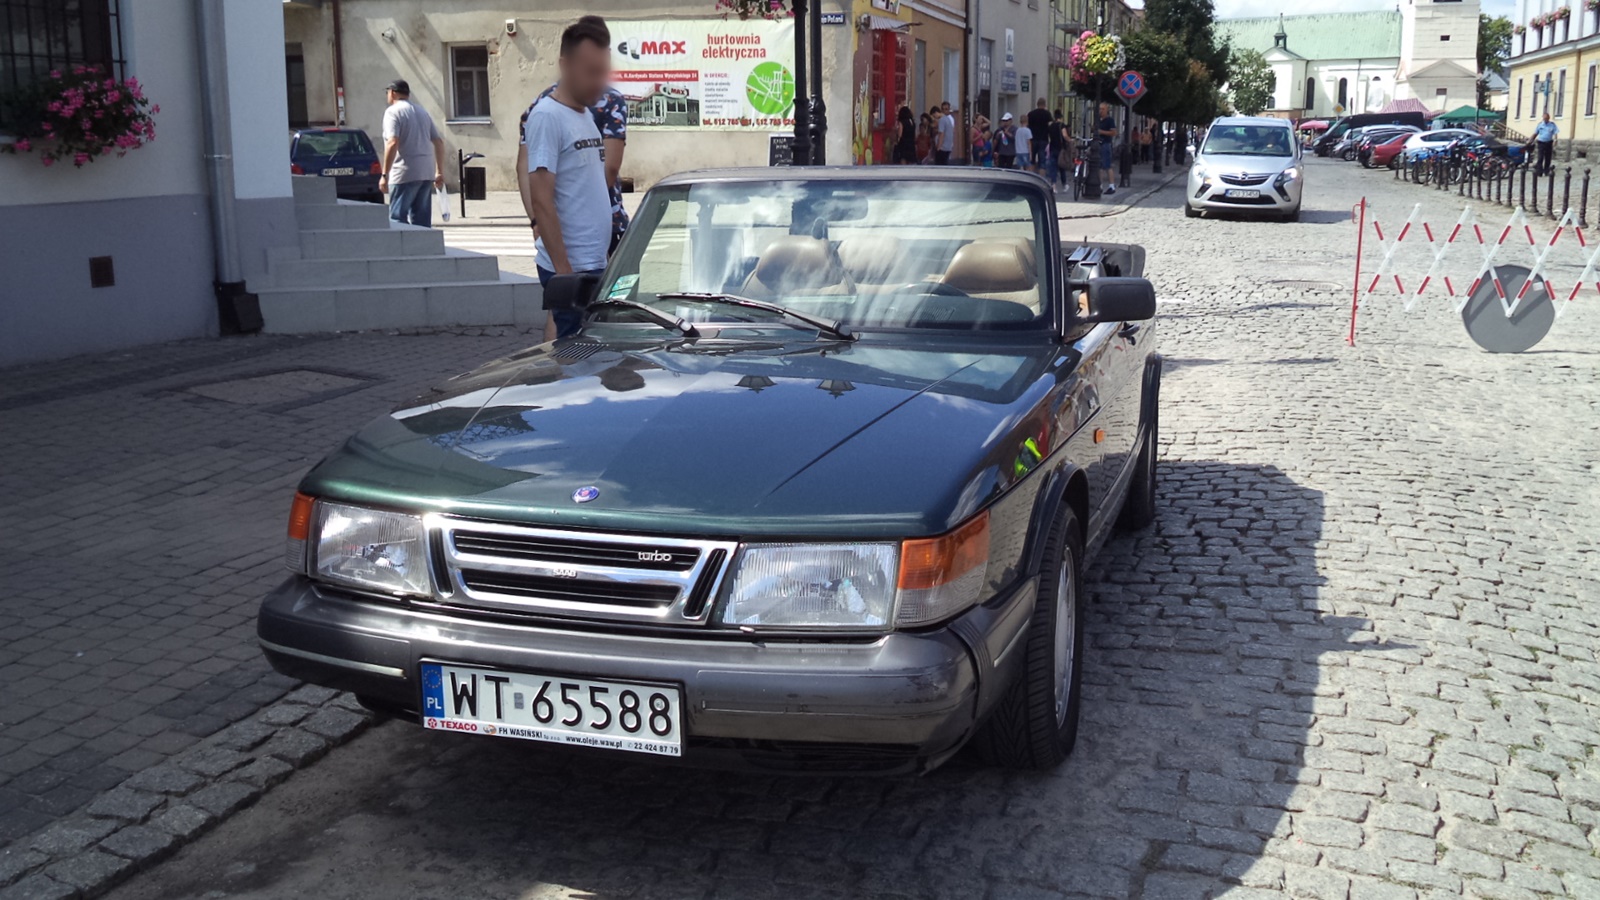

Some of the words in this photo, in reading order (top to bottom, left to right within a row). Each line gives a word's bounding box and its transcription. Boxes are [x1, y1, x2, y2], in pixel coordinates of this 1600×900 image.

[707, 33, 761, 45] hurtownia
[702, 46, 767, 61] elektryczna
[638, 550, 672, 562] turbo
[553, 568, 577, 579] SAAB
[426, 697, 442, 709] PL
[450, 672, 510, 719] WT
[532, 681, 672, 737] 65588
[440, 720, 478, 732] TEXACO
[498, 727, 508, 735] FH
[509, 727, 542, 739] WASIŃSKI
[566, 735, 623, 748] www.oleje.waw.pl
[634, 742, 643, 750] 22
[645, 743, 657, 751] 424
[670, 746, 679, 754] 79
